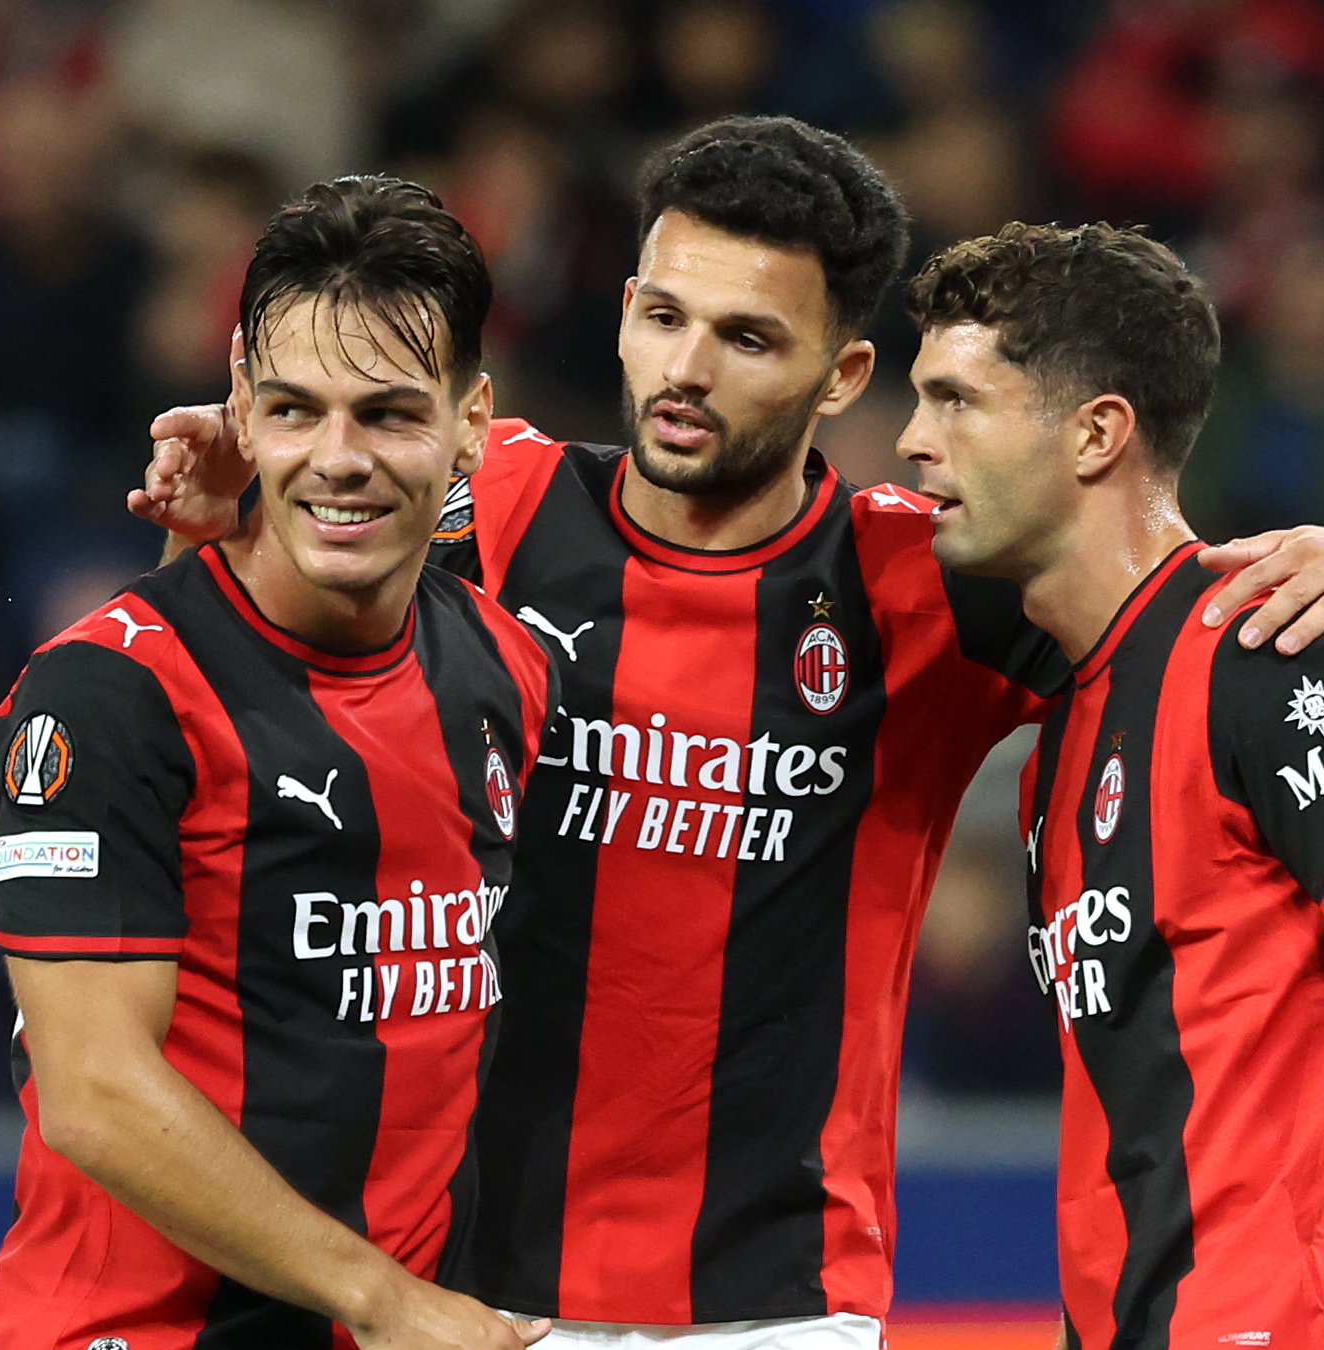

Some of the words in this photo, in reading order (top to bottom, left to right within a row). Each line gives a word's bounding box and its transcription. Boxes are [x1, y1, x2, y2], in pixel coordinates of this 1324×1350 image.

[807, 630, 837, 646] ACM
[810, 694, 835, 704] 1899
[558, 784, 631, 844] FLY
[636, 796, 794, 863] BETTER
[336, 964, 400, 1022] FLY
